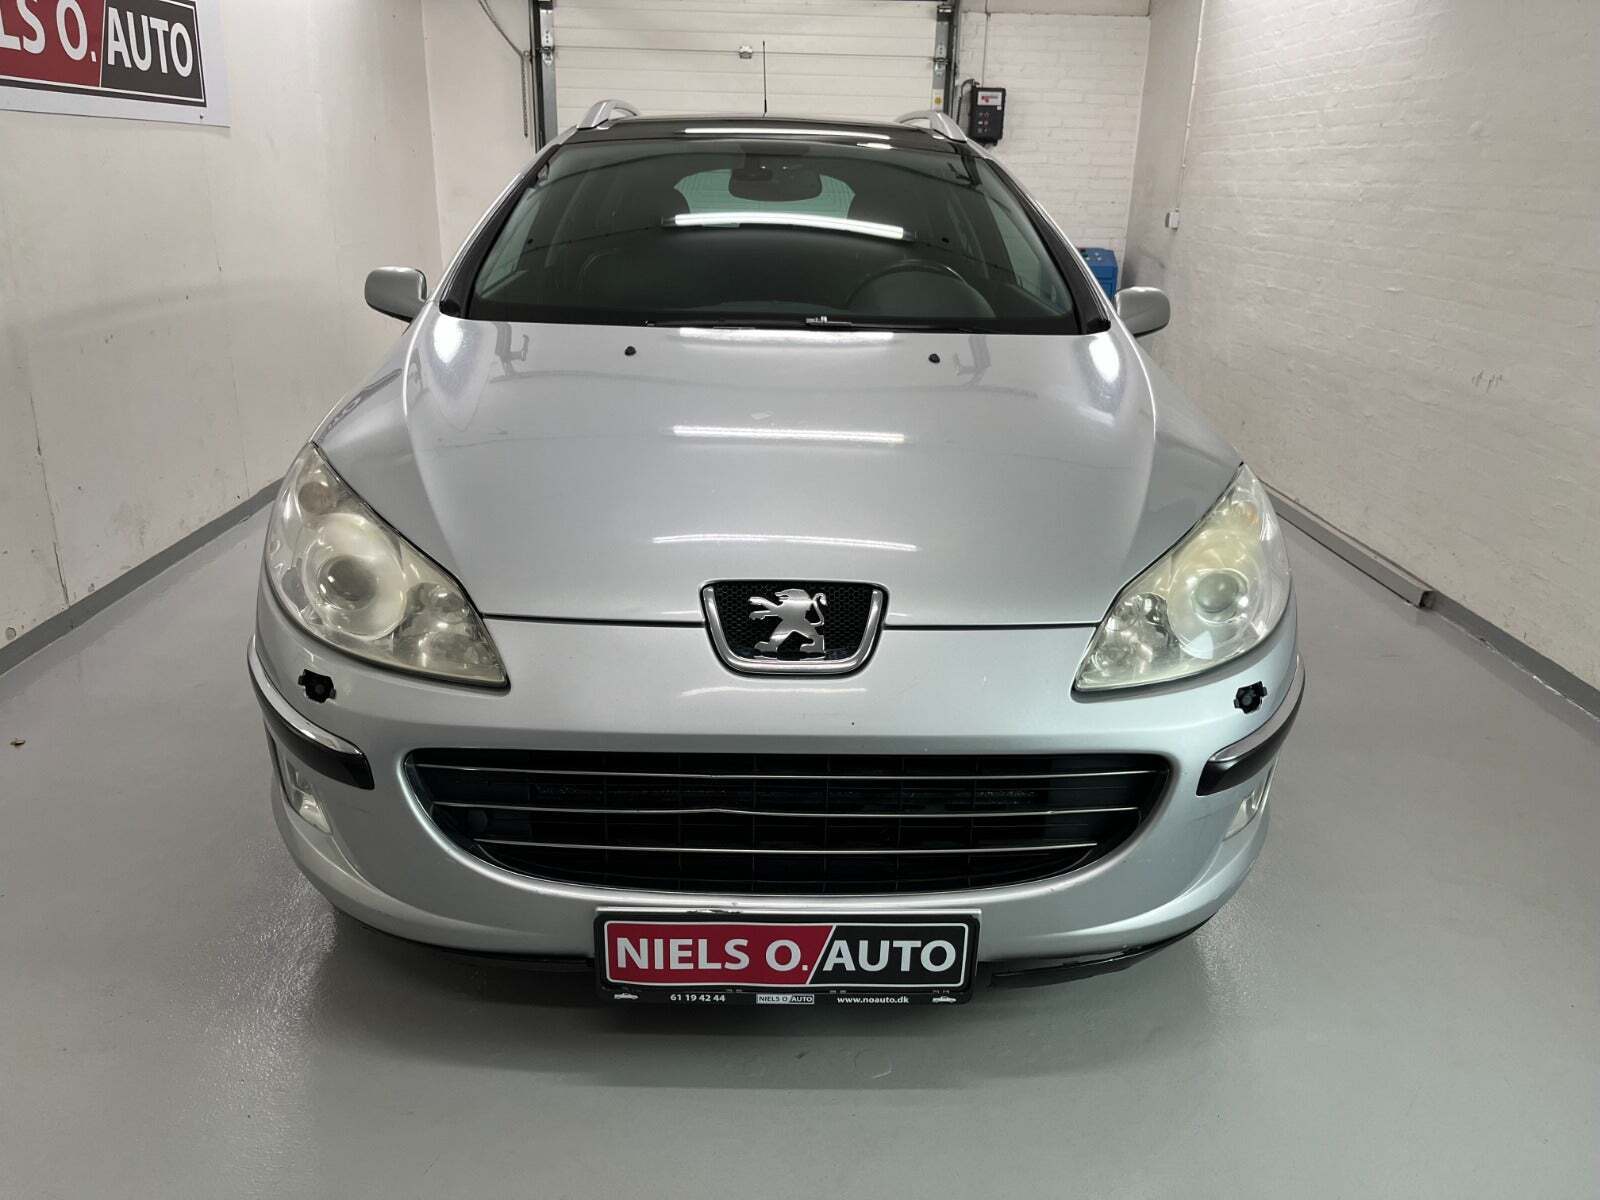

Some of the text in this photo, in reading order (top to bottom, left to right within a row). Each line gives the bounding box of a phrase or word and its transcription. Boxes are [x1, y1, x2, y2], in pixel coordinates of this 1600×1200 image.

[107, 6, 193, 77] AUTO
[616, 937, 956, 972] NIELS O. AUTO
[670, 993, 726, 1002] 61 19 42 44
[791, 995, 813, 1003] AUTO
[837, 996, 910, 1004] www.noauto.dk
